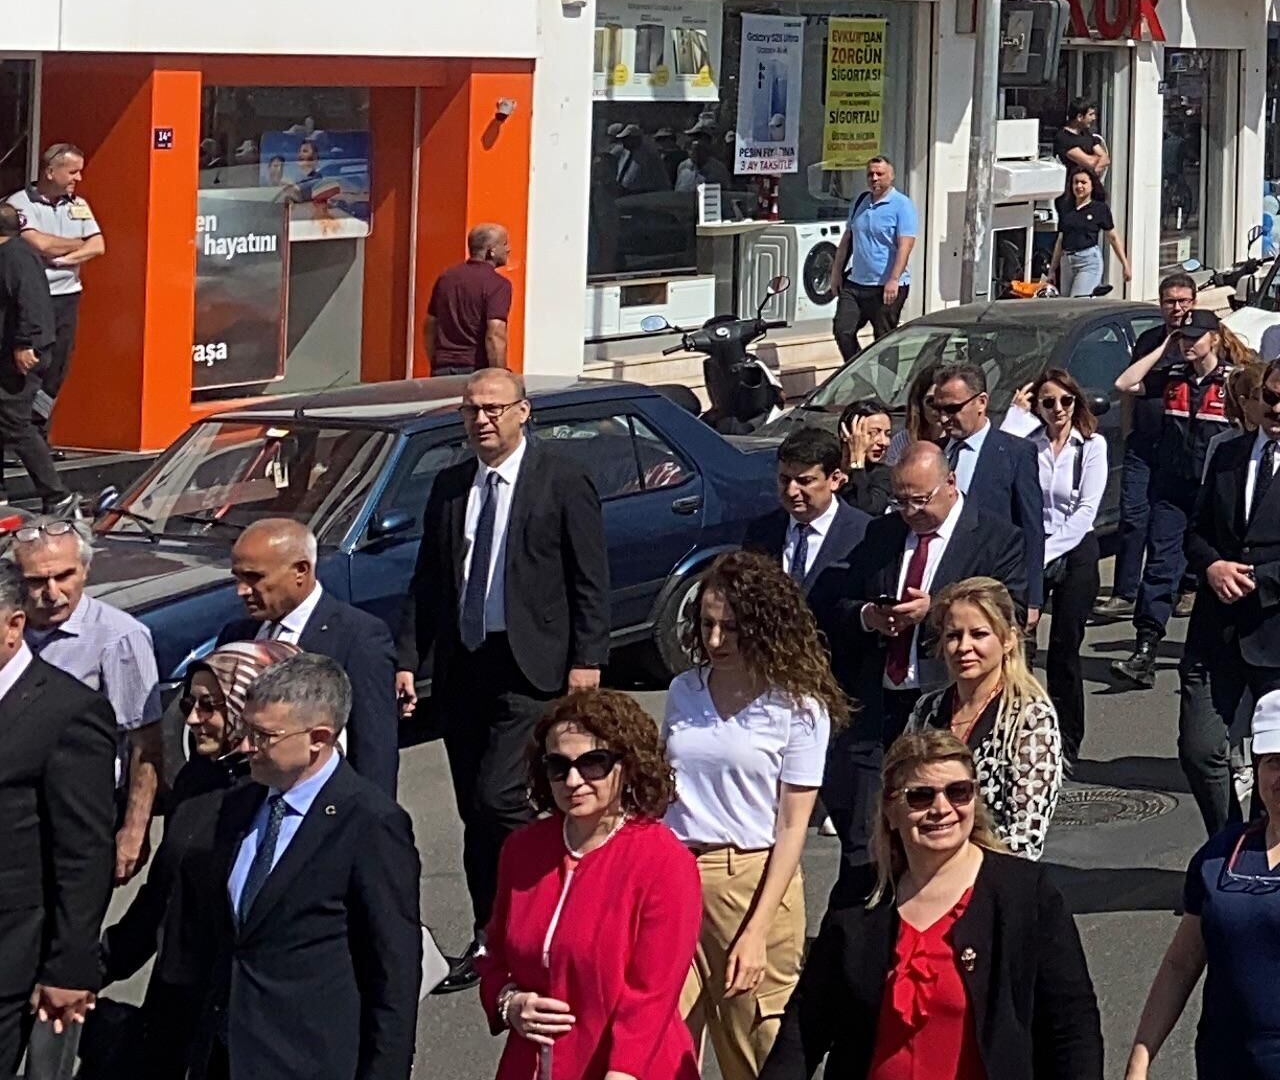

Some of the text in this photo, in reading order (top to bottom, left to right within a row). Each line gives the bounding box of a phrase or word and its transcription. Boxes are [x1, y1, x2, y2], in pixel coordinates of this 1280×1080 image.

[831, 45, 882, 64] ZORGÜN
[831, 65, 881, 81] SİGORTASI
[829, 107, 880, 124] SİGORTALI
[204, 234, 277, 260] hayatını
[193, 342, 227, 366] aşa
